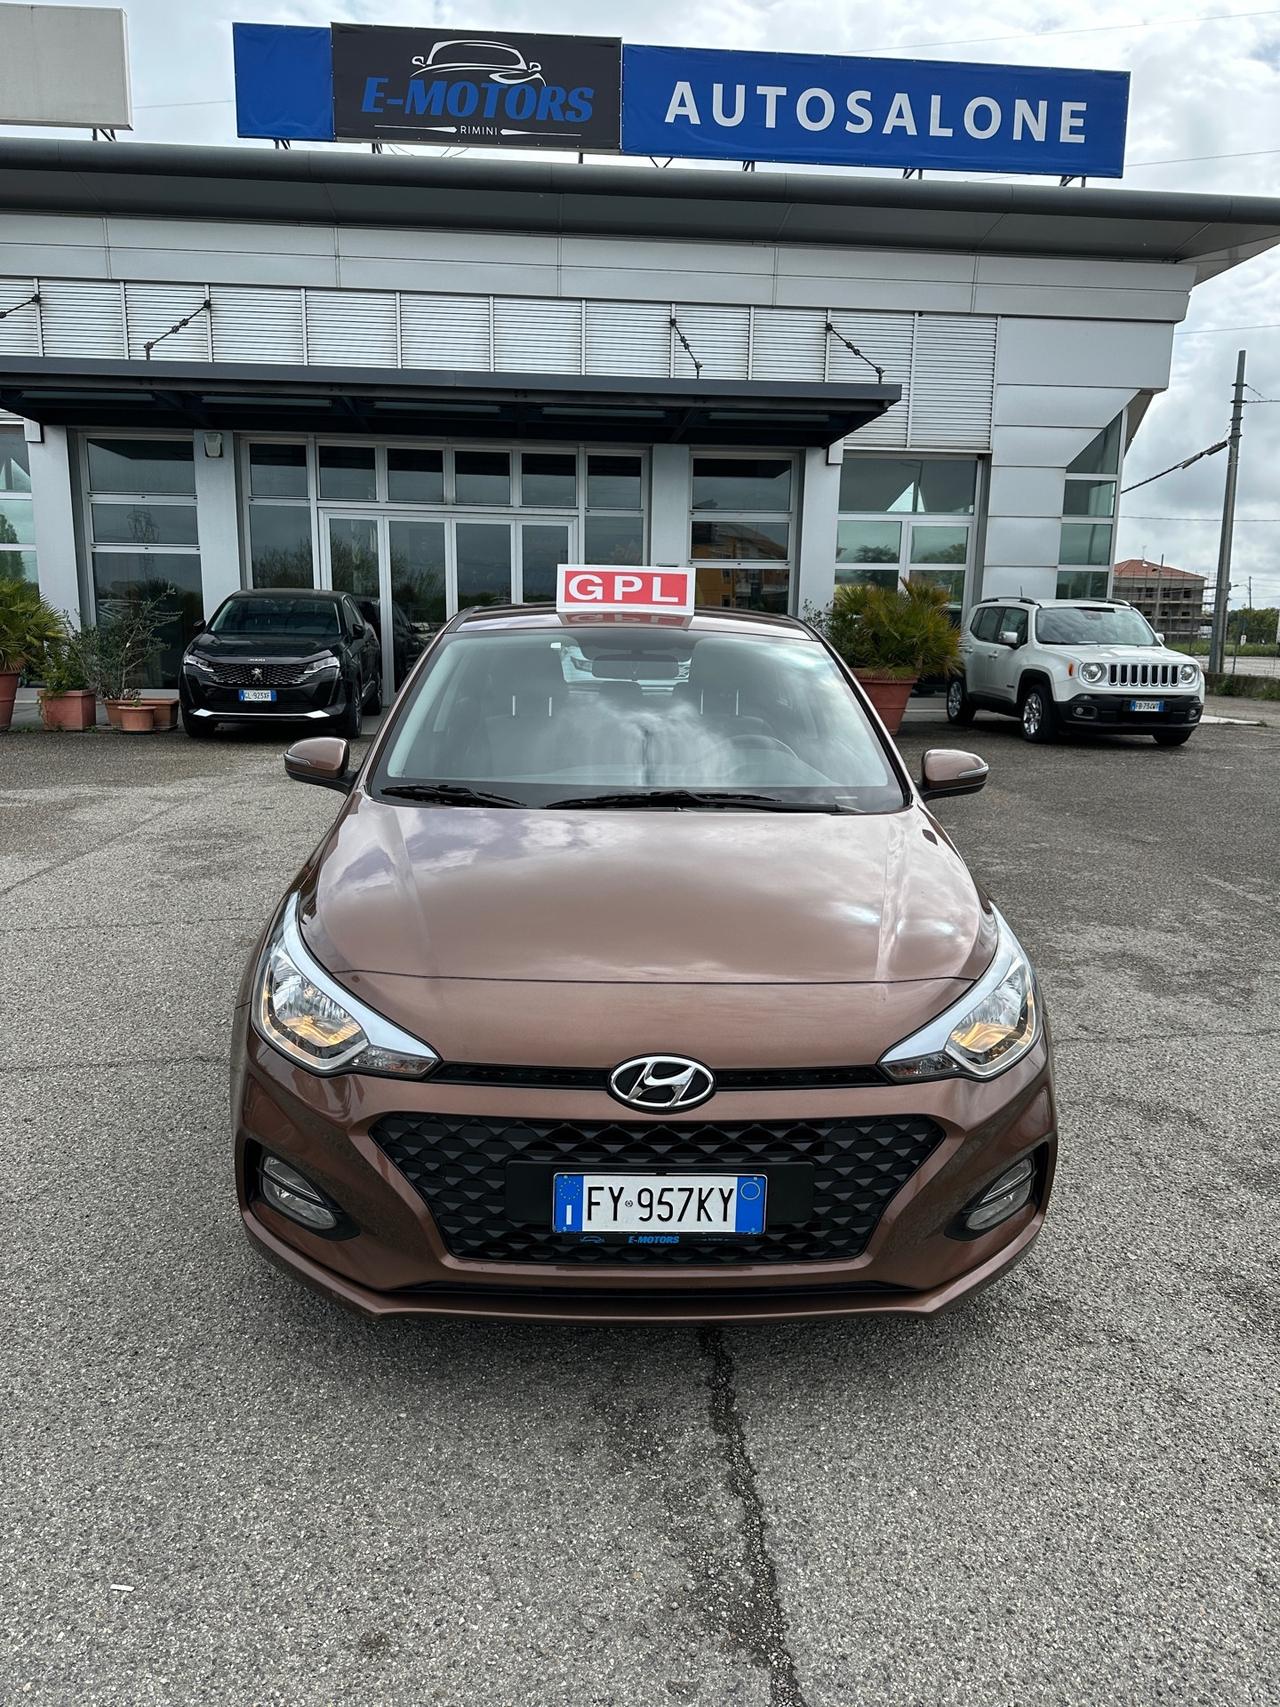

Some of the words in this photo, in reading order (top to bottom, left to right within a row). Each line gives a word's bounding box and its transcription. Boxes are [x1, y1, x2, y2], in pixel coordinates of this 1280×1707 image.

[360, 76, 595, 123] E-MOTORS
[663, 81, 1087, 144] AUTOSALONE
[460, 125, 499, 137] RIMINI
[568, 574, 679, 603] GPL
[628, 1235, 680, 1244] E-MOTORS
